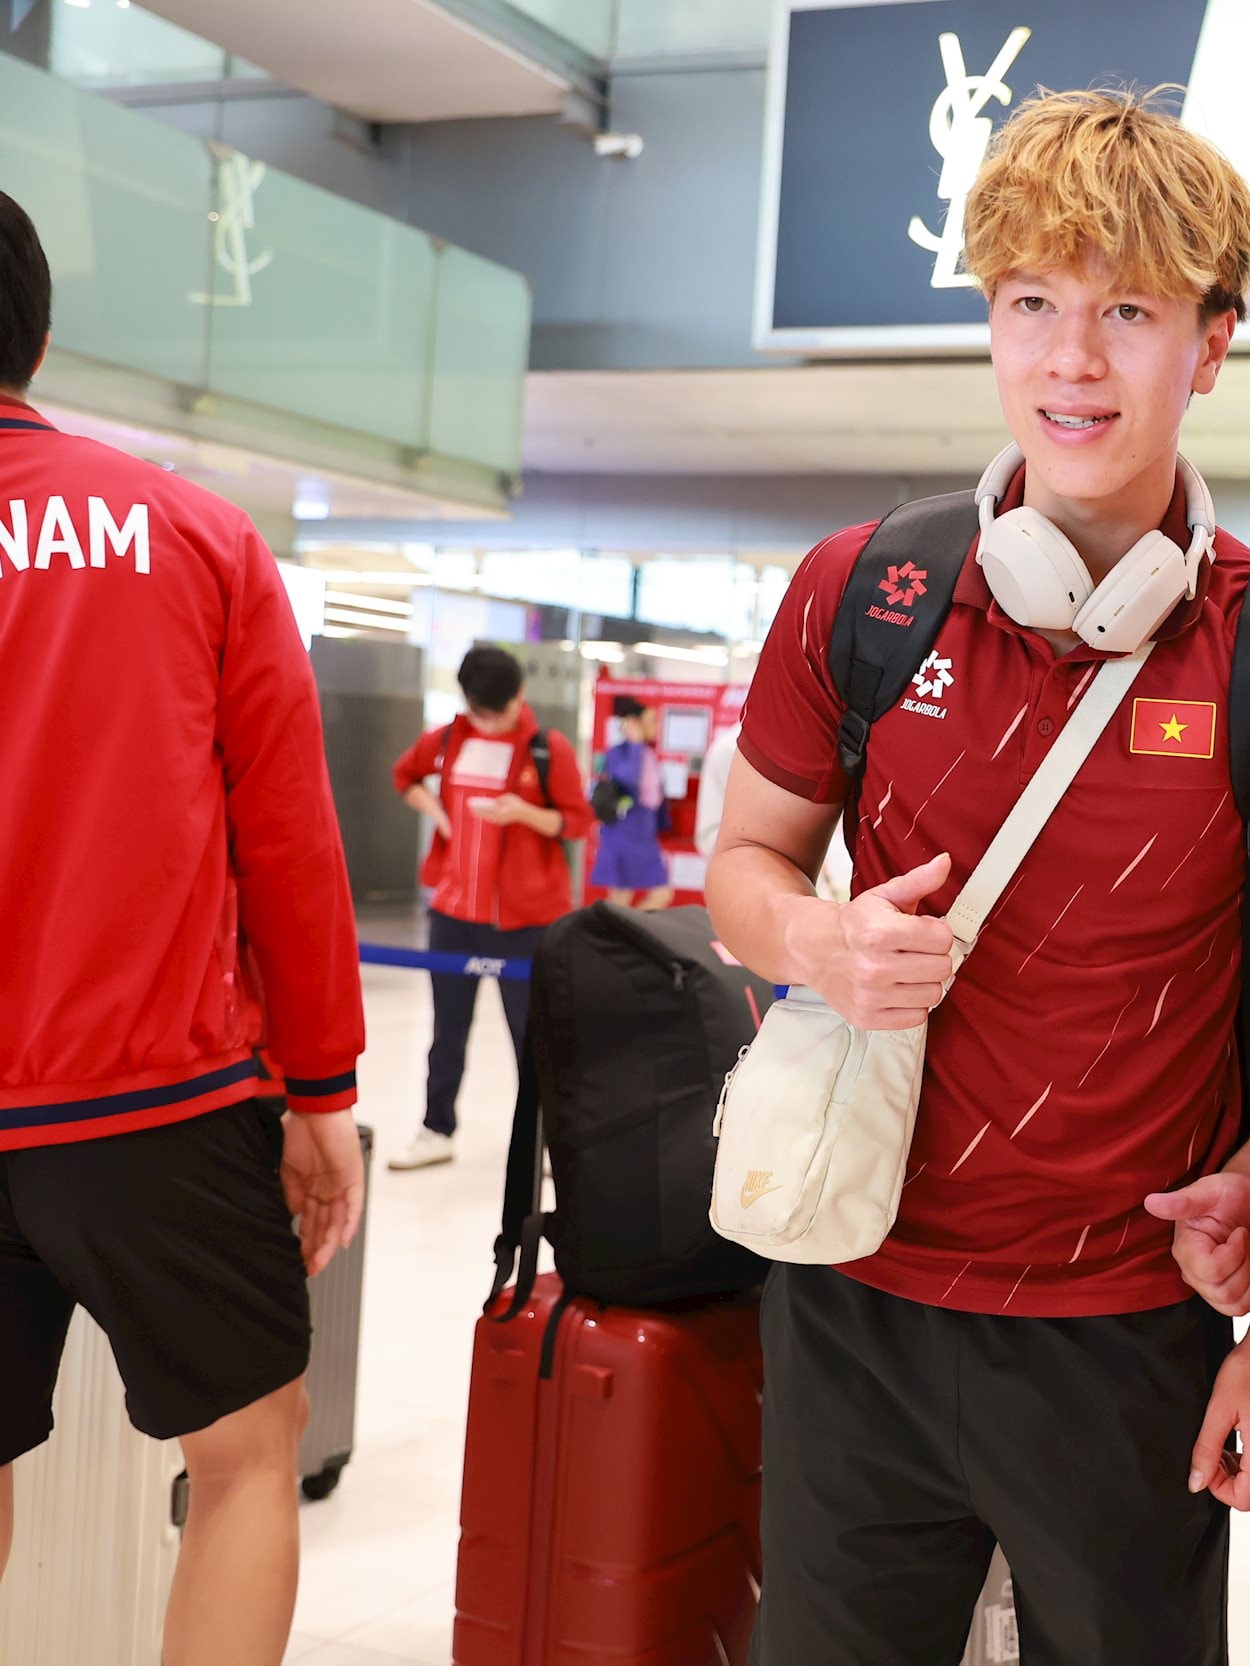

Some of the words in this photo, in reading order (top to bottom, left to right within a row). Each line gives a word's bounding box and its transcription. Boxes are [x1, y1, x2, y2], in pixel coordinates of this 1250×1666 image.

[0, 495, 150, 580] NAM
[865, 605, 914, 627] JOGARBOLA
[900, 698, 947, 719] JOGARBOLA
[744, 1170, 773, 1192] NIKE
